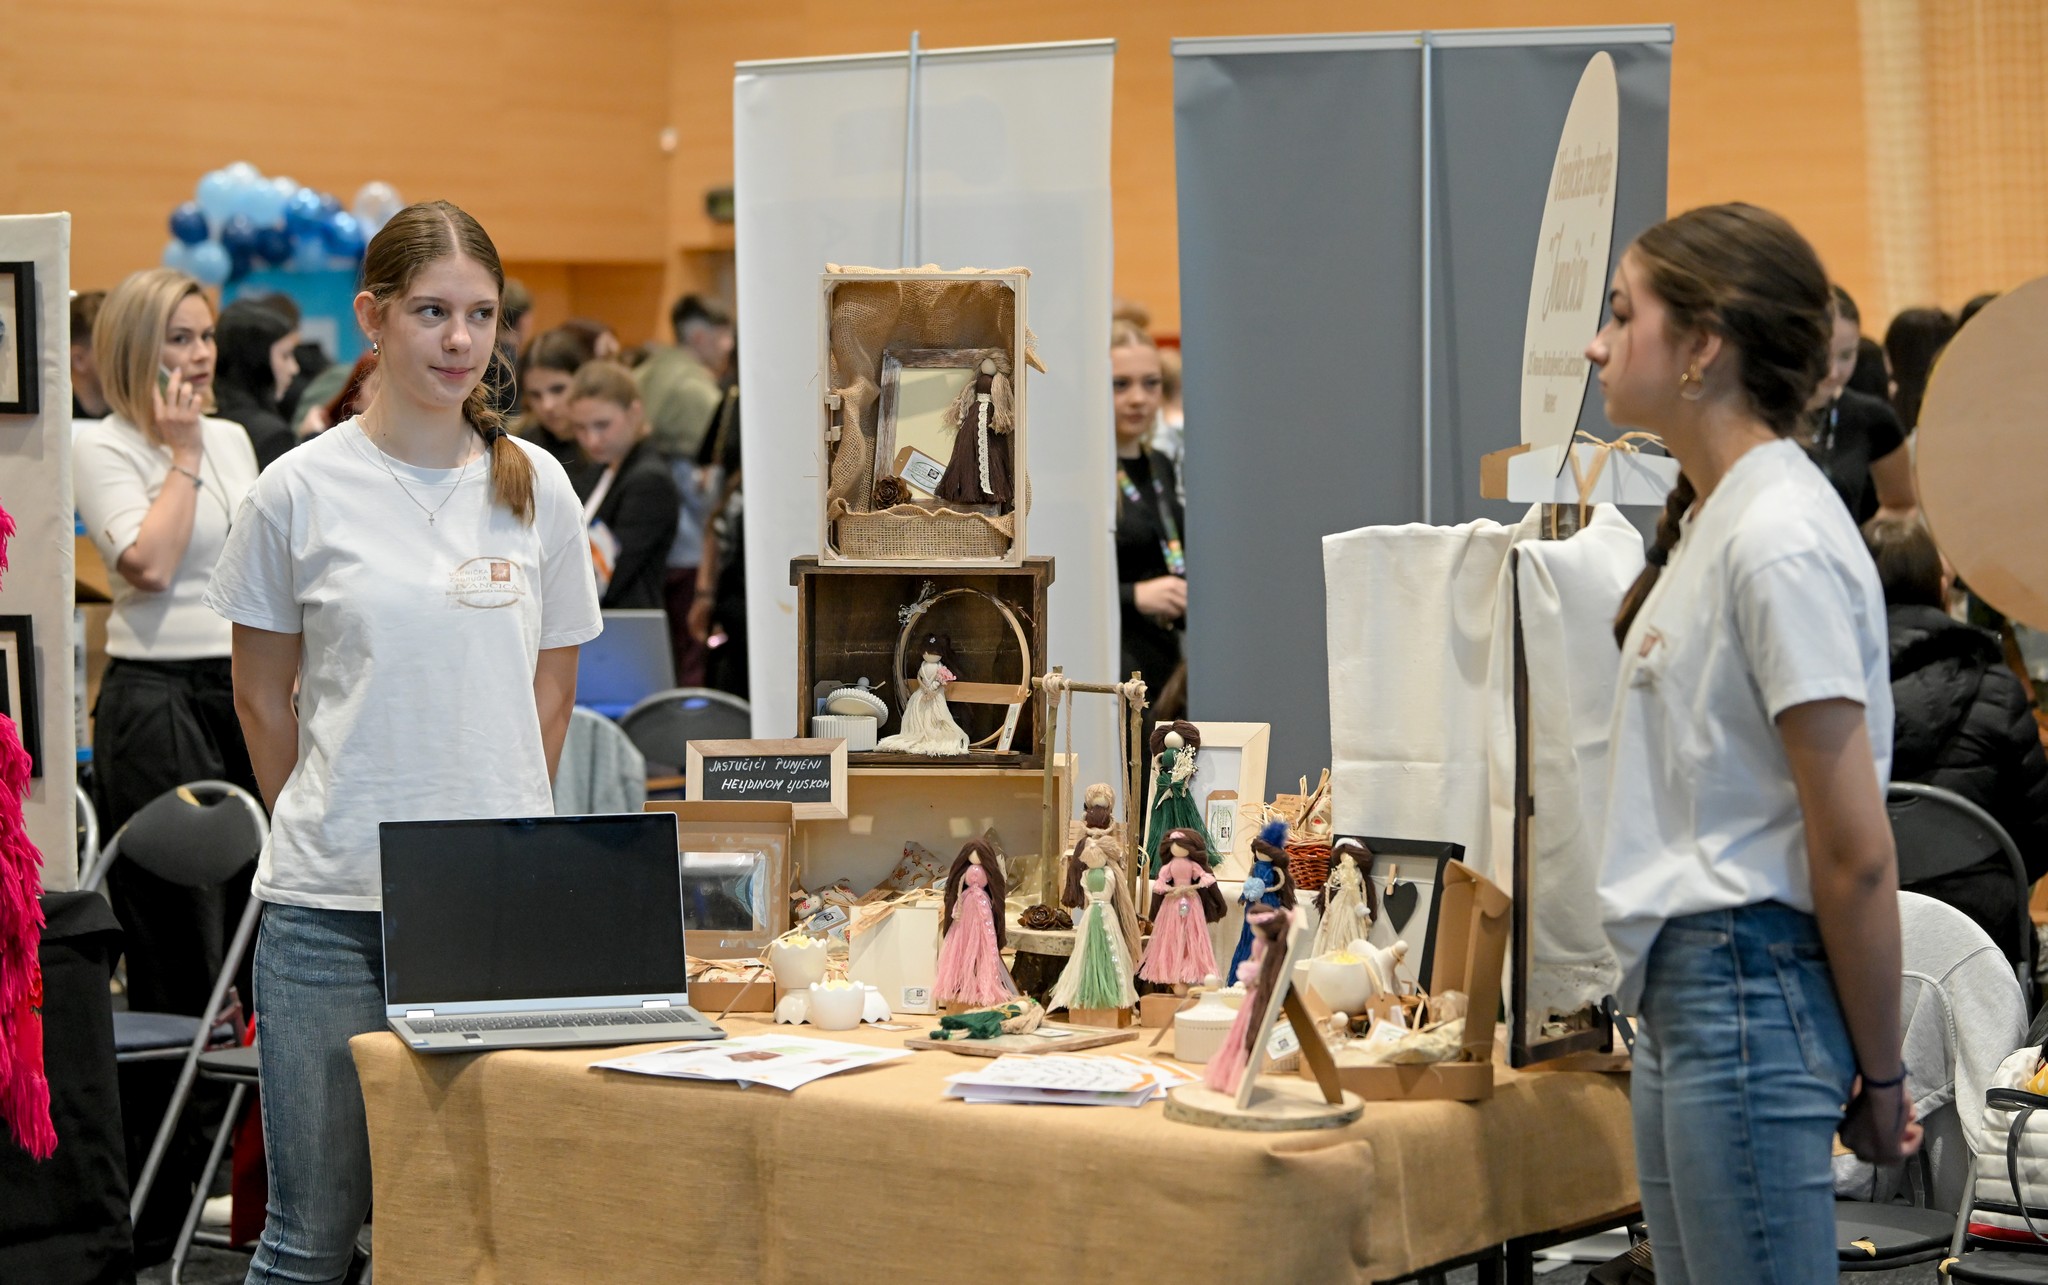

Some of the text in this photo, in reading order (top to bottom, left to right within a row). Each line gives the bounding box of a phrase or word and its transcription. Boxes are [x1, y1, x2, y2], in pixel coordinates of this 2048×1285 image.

[708, 757, 822, 774] JASTUČIĆI PUNJENI
[721, 778, 830, 794] HELJDINOM LJUSKOM
